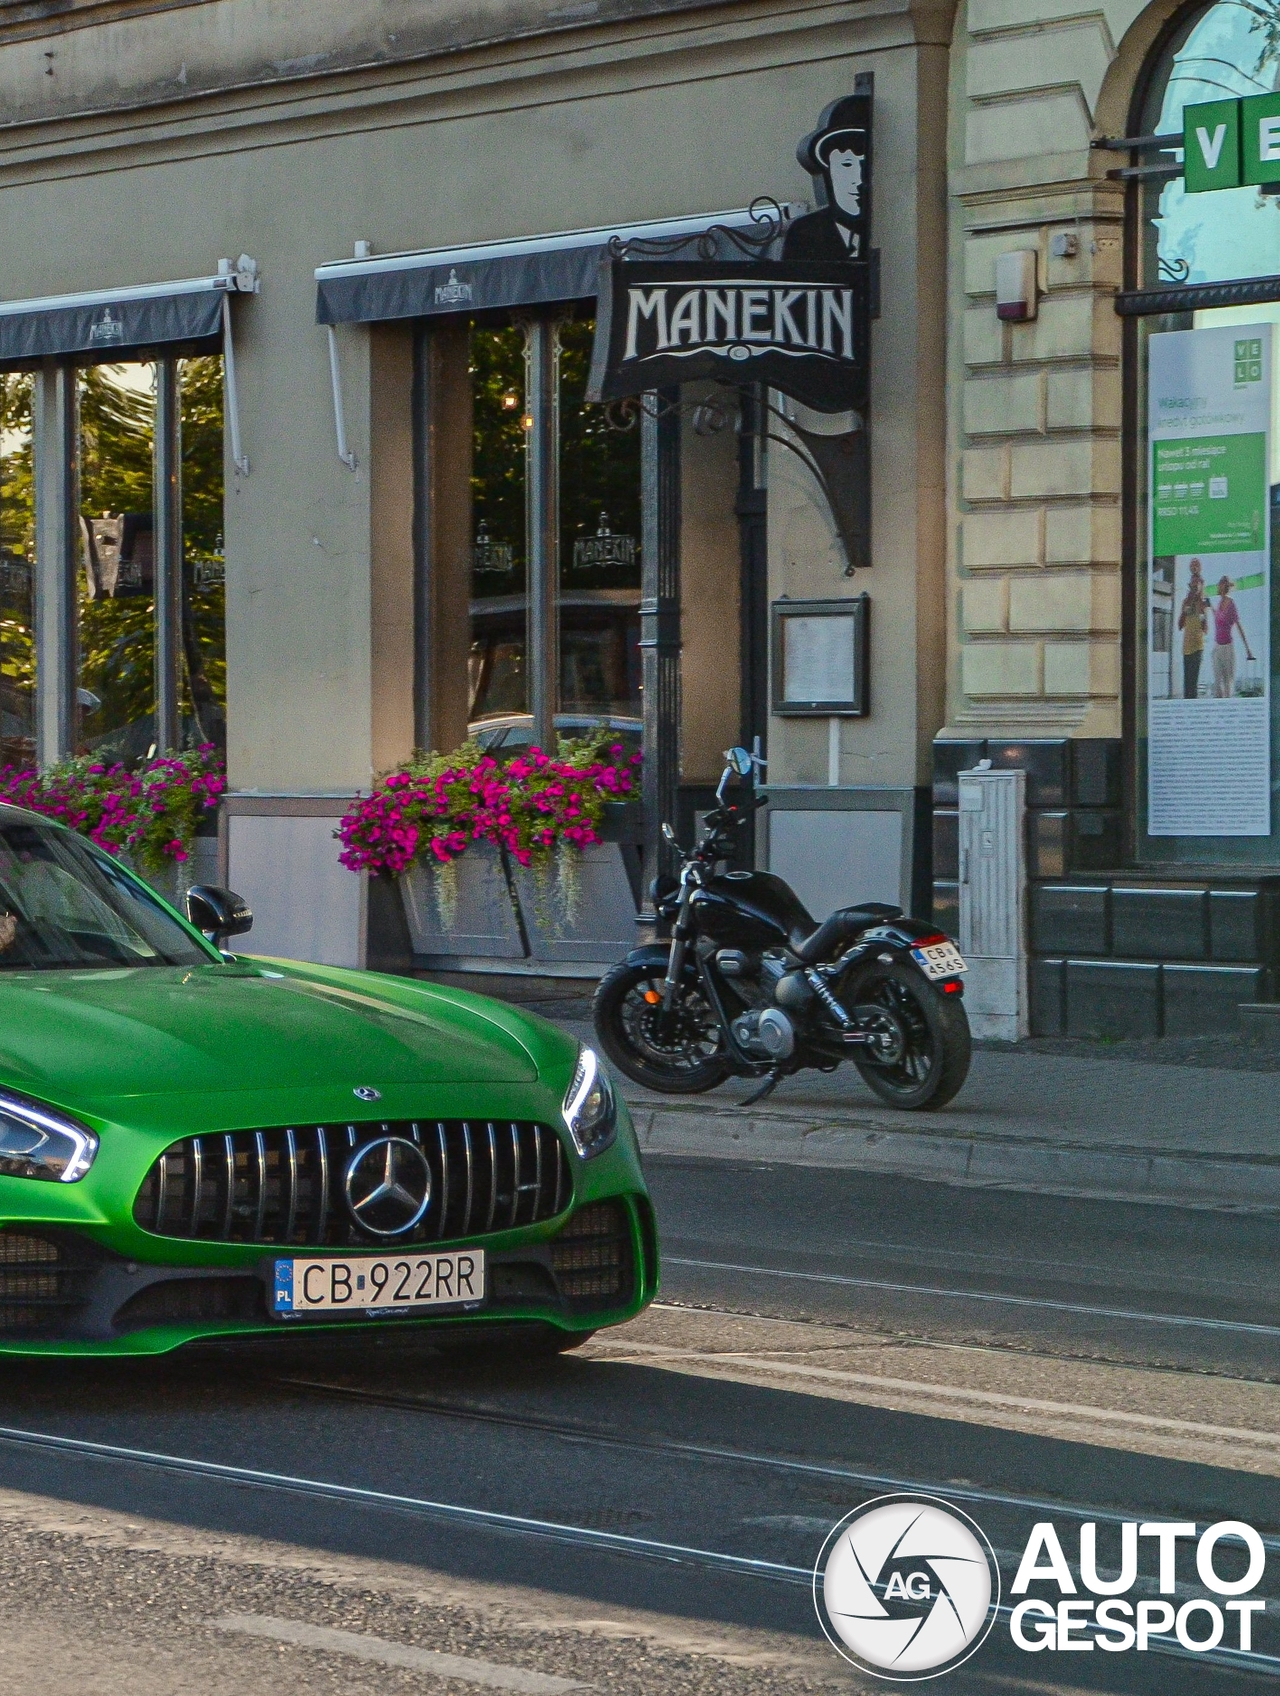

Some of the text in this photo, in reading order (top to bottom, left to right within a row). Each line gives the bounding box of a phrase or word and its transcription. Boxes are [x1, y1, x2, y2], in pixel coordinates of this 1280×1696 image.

[622, 289, 855, 361] MANEKIN
[573, 537, 636, 568] MANEKIN
[927, 947, 946, 960] CB
[303, 1256, 475, 1304] CB 922RR
[277, 1290, 291, 1302] PL
